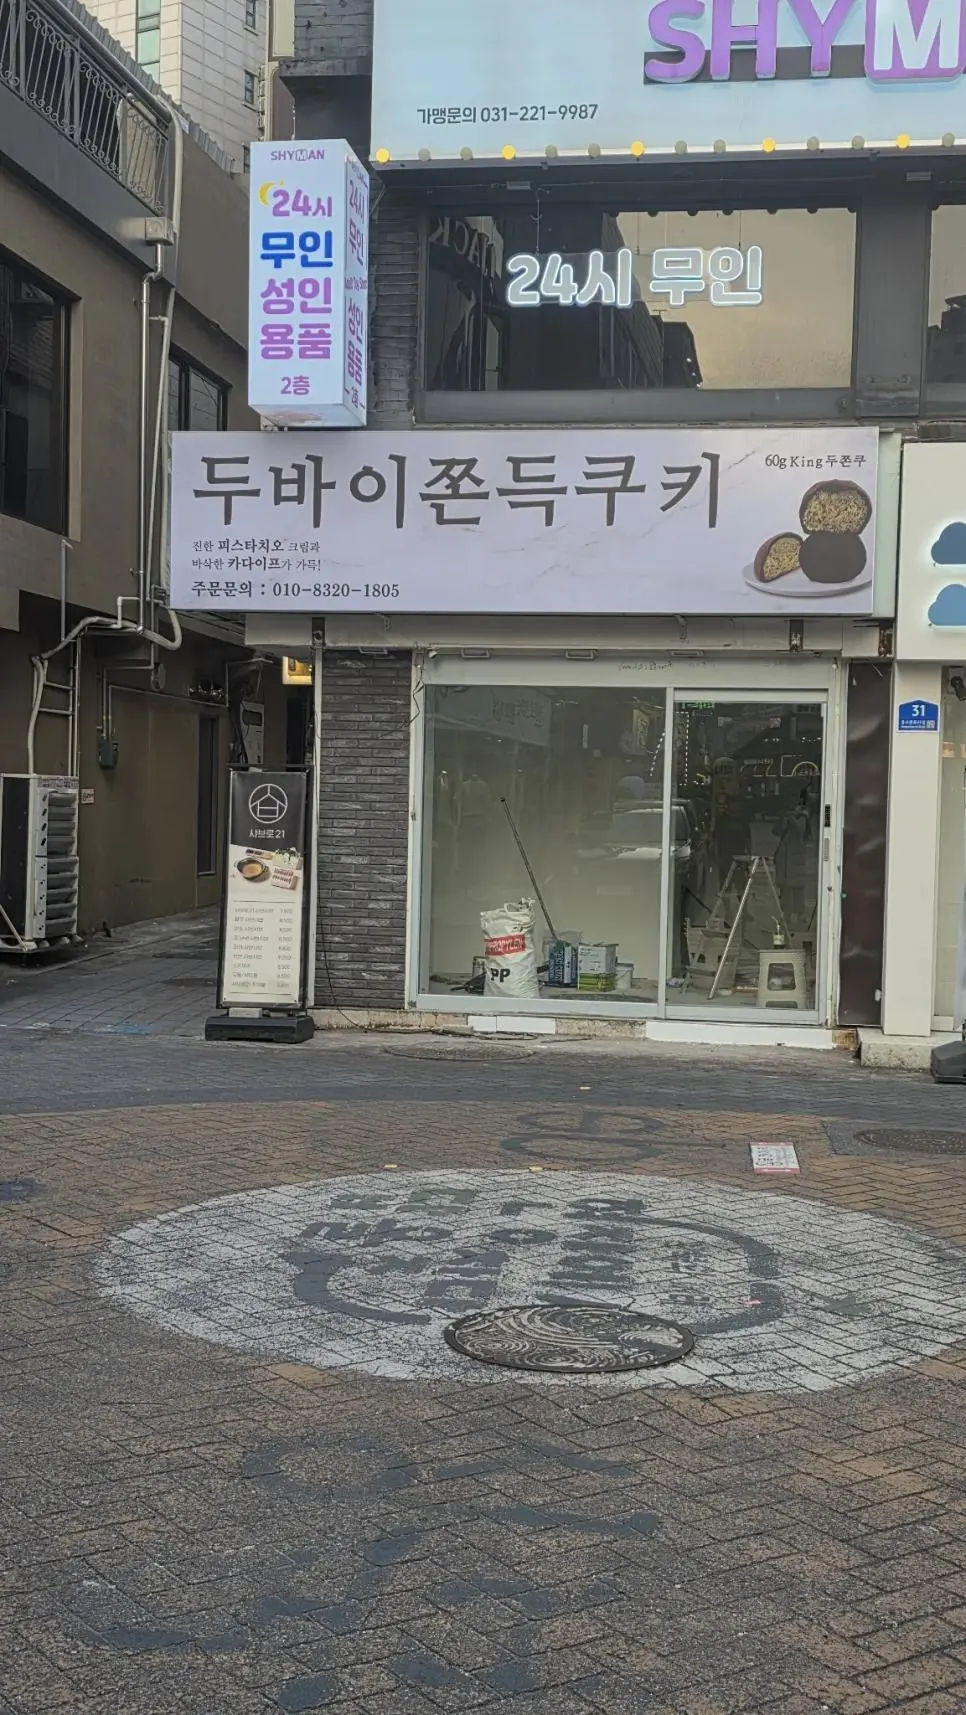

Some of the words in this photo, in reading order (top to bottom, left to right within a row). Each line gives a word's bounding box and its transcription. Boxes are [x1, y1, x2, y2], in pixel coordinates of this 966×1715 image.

[417, 106, 476, 125] 가맹문의
[481, 104, 598, 123] 031-221-9987
[270, 149, 325, 162] SHYMAN
[272, 188, 333, 217] 24시
[349, 179, 364, 225] 24시
[260, 230, 333, 269] 무인
[349, 217, 363, 267] 무인
[506, 247, 633, 308] 24시
[649, 246, 763, 307] 무인
[260, 277, 333, 315] 성인
[348, 296, 363, 345] 성인
[260, 322, 333, 360] 용품
[280, 375, 311, 396] 2층
[765, 454, 787, 469] 60g
[790, 455, 823, 469] King
[825, 454, 866, 468] 두쫀쿠
[192, 451, 721, 528] 두바이쫀득쿠키
[193, 540, 214, 552] 진한
[218, 538, 284, 553] 피스타치오
[288, 541, 320, 553] 크림과
[192, 558, 224, 570] 바삭한
[228, 556, 292, 571] 카다이프가
[296, 559, 321, 572] 가득!
[192, 580, 253, 598] 주문문의
[273, 582, 400, 598] 010-8320-1805
[911, 704, 925, 717] 31
[490, 967, 511, 983] PP
